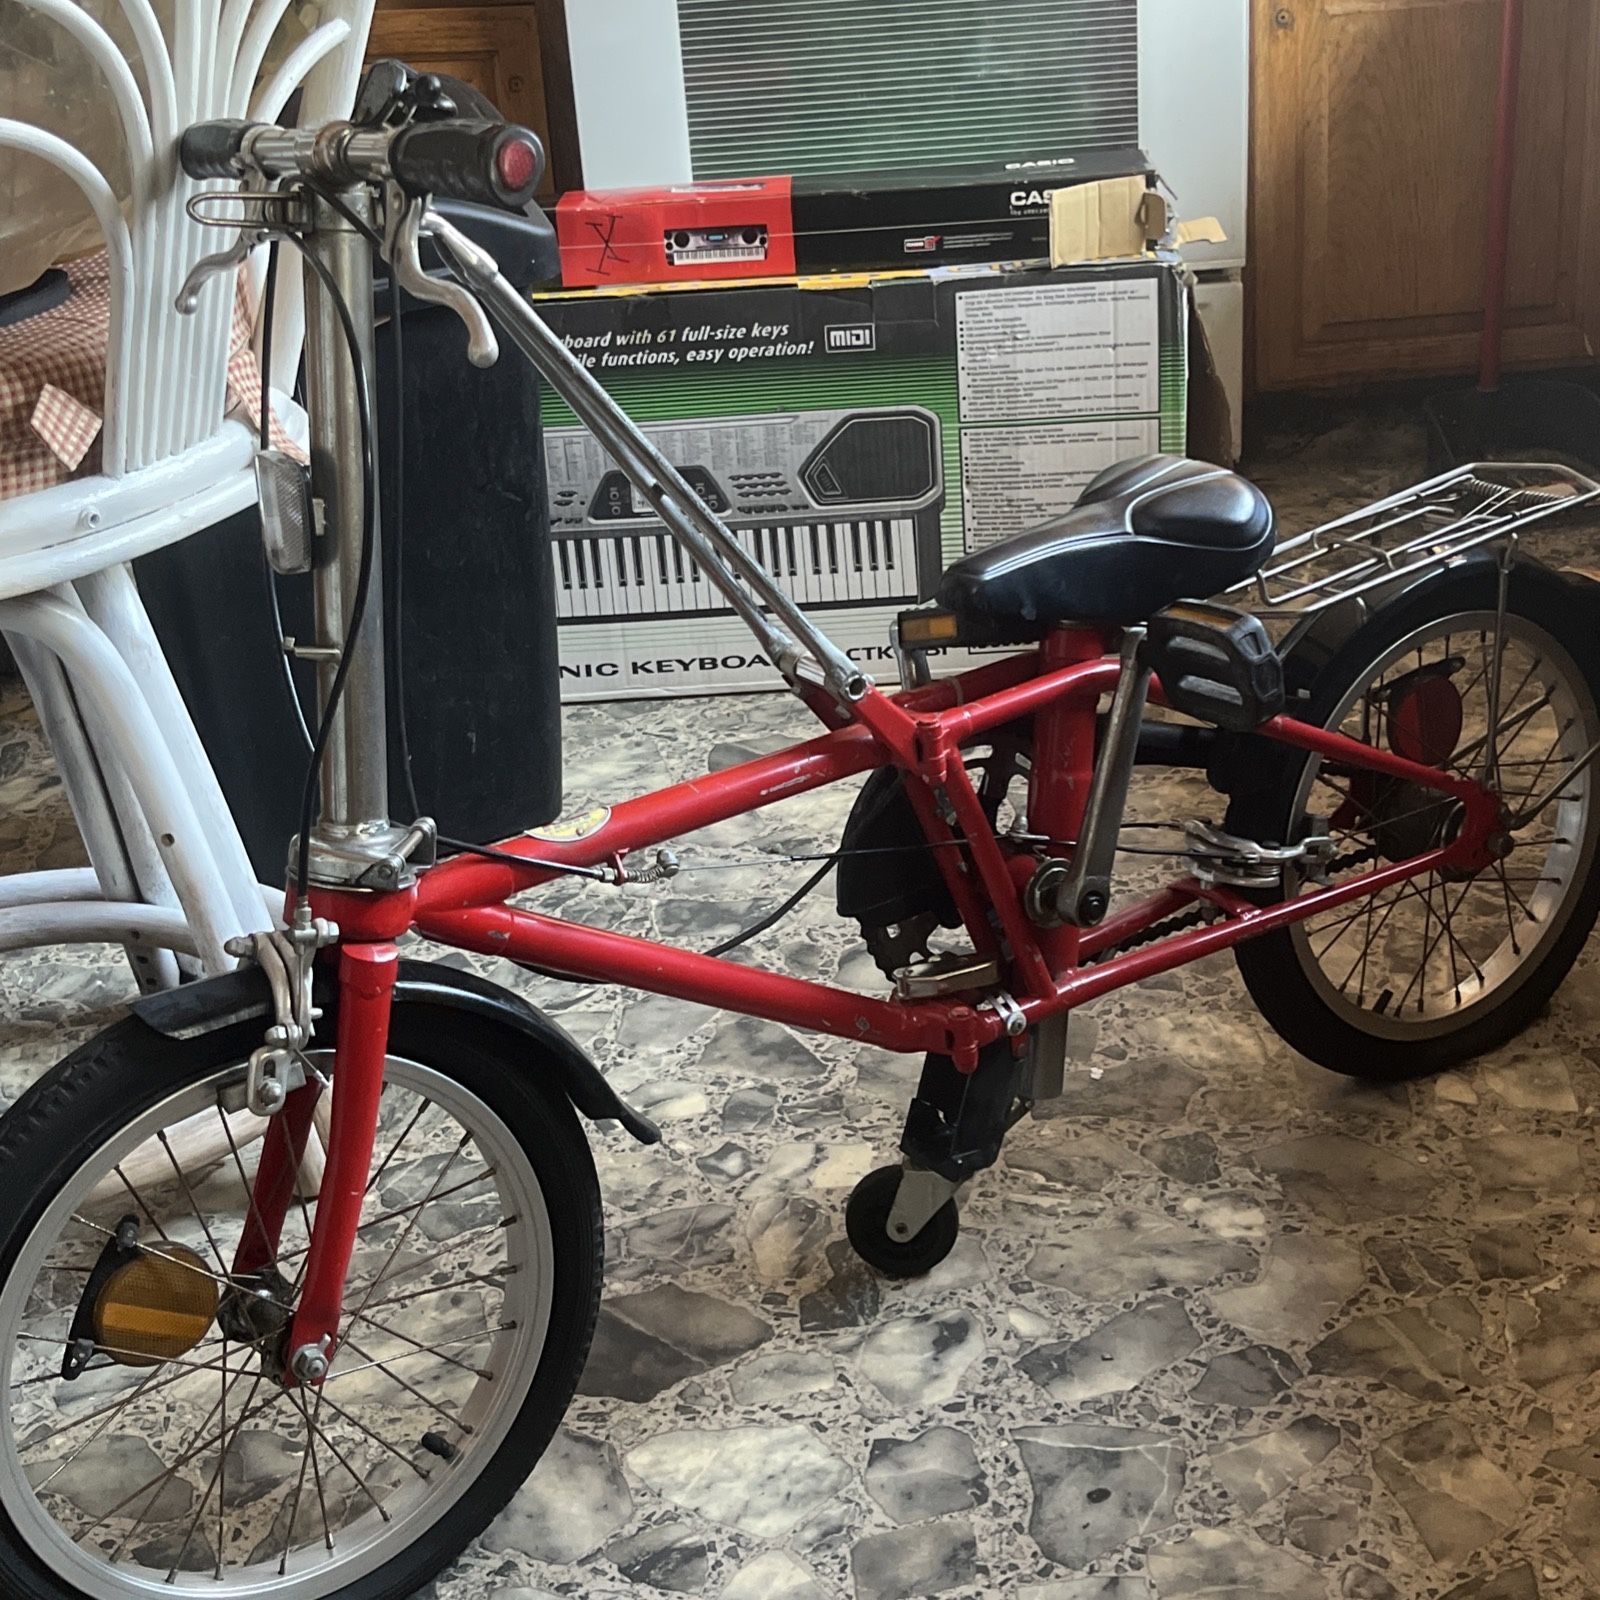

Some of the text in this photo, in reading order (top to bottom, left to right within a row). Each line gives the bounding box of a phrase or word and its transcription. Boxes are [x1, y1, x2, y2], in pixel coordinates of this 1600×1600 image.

[616, 328, 652, 346] with
[657, 329, 677, 343] 61
[681, 325, 747, 342] full-size
[751, 322, 790, 340] keys
[829, 329, 871, 347] MIDI
[577, 340, 815, 369] ile functions, easy operation!
[631, 654, 771, 675] KEYBOA
